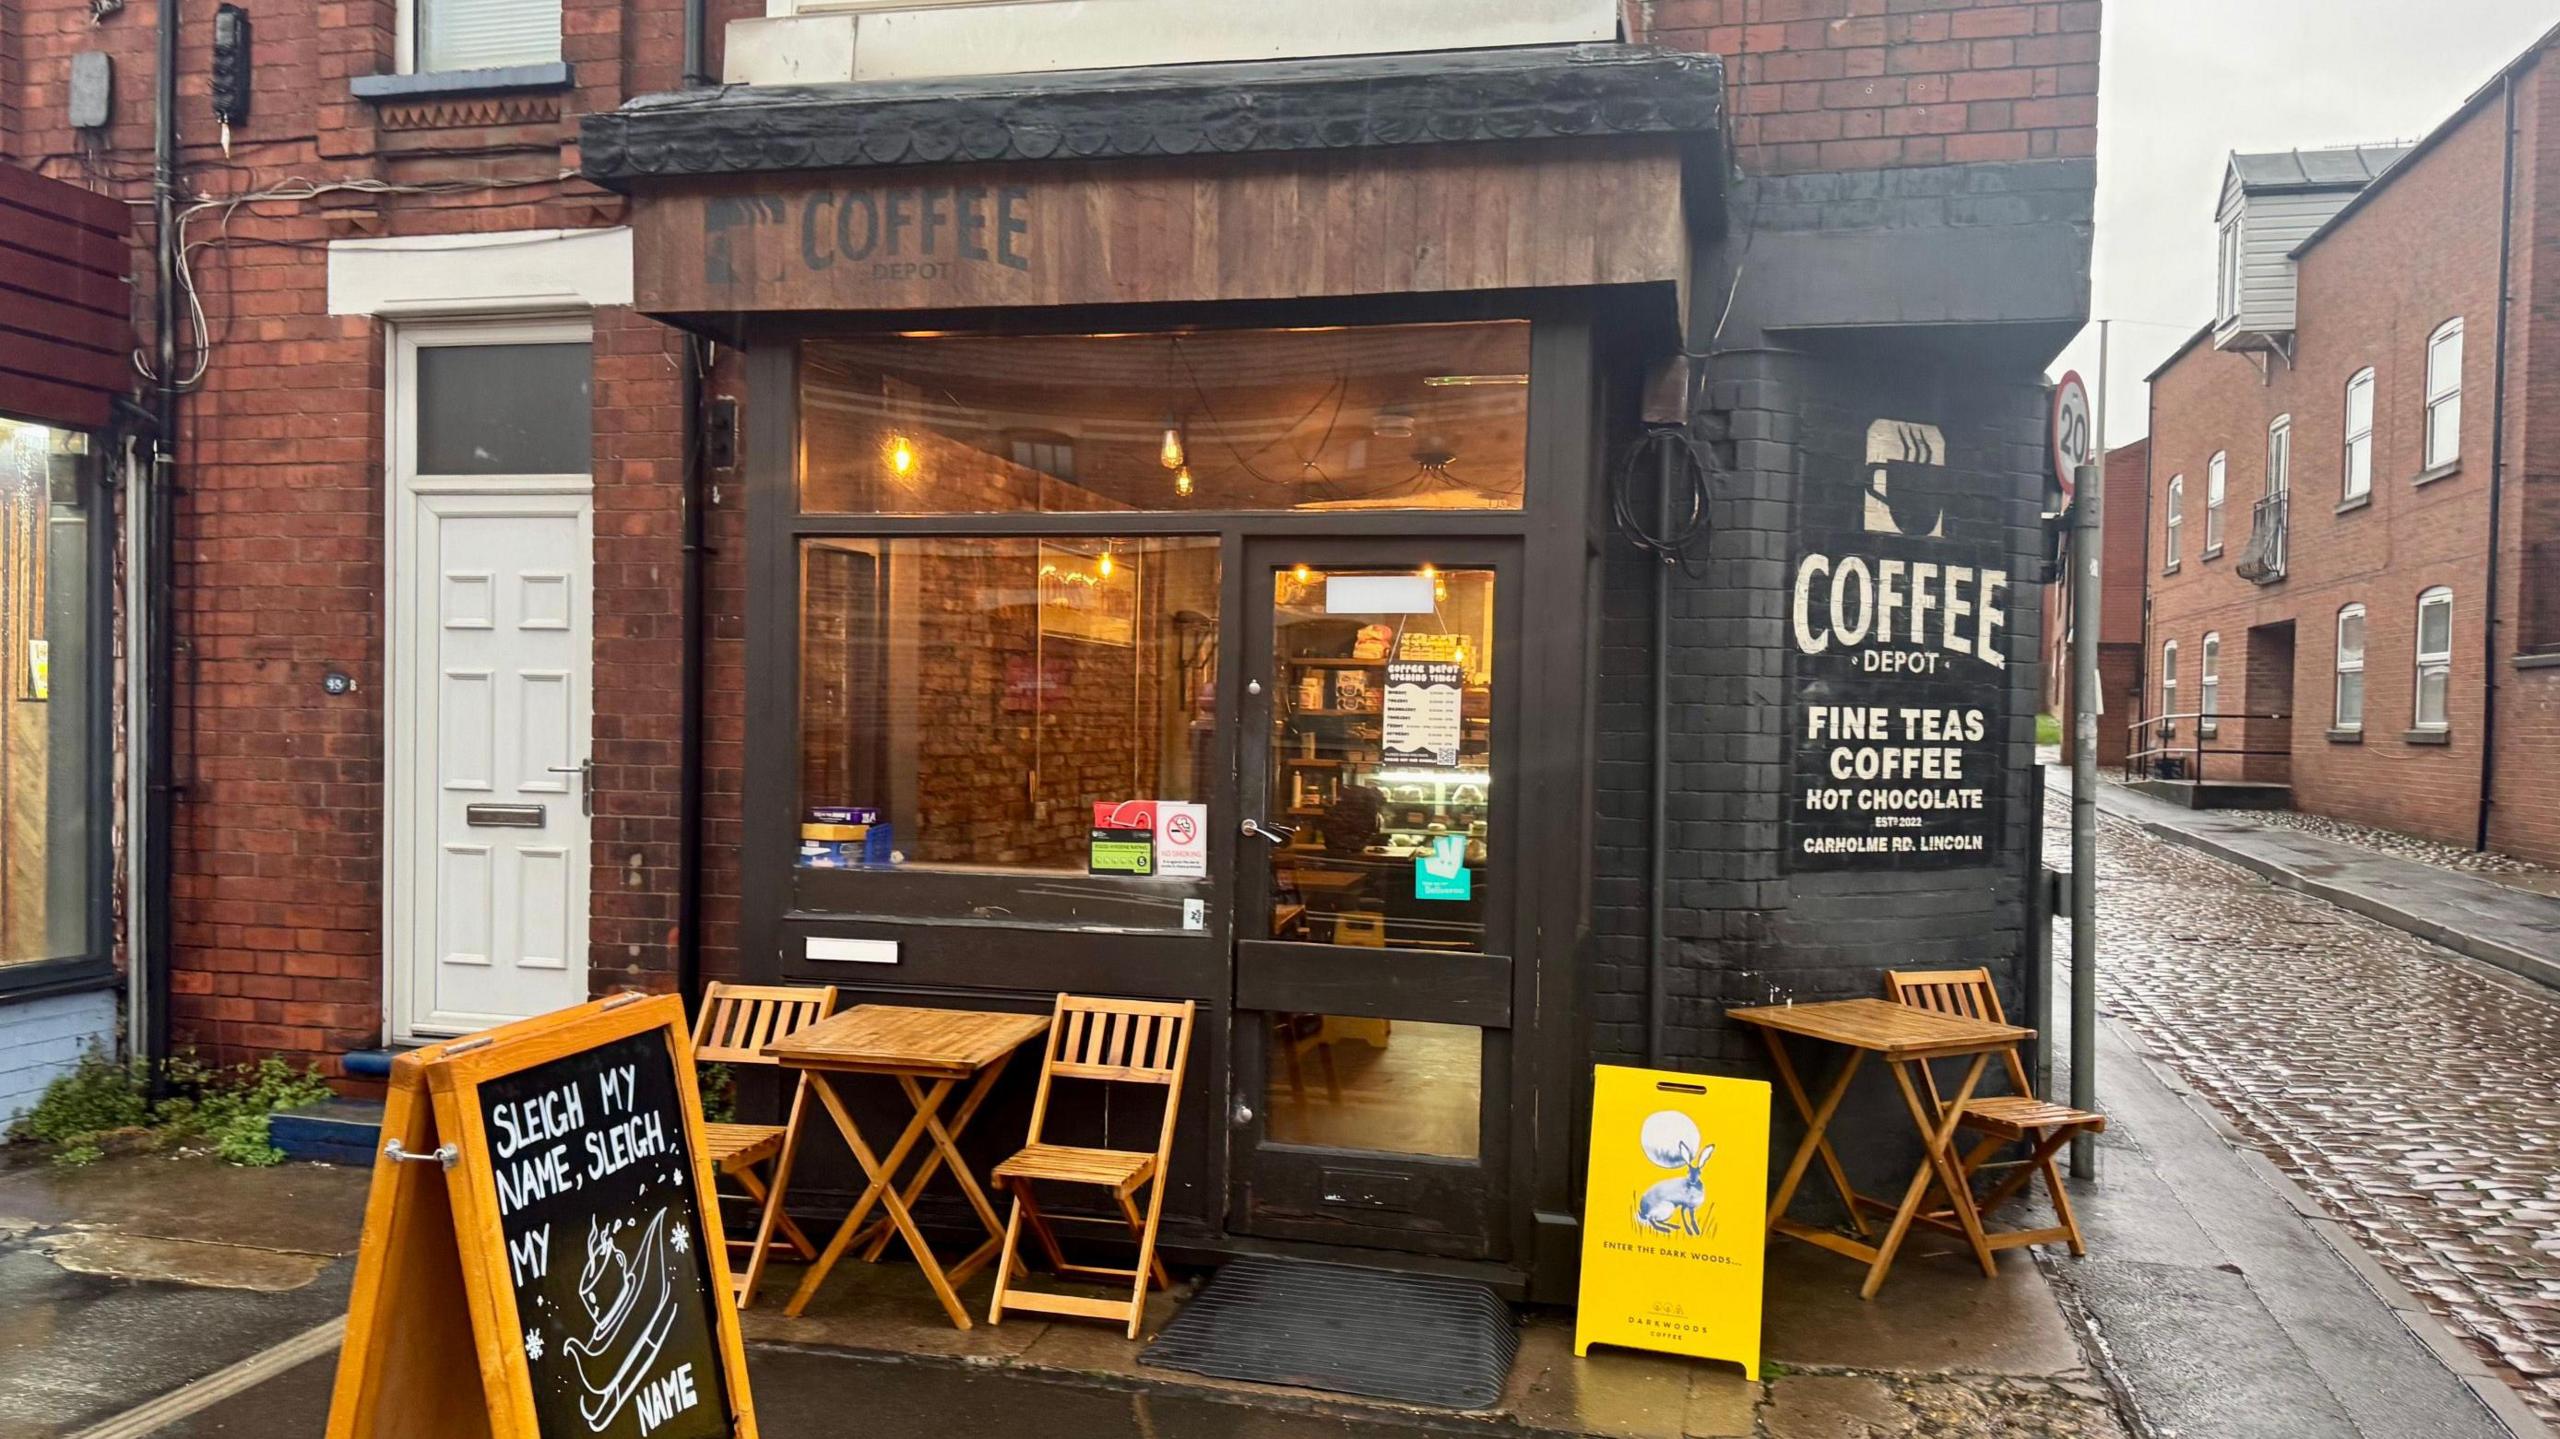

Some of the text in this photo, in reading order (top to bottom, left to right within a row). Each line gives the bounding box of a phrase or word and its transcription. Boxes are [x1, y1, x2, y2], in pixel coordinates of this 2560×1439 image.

[803, 184, 1028, 271] COFFEE
[872, 261, 950, 279] DEPOT
[2061, 403, 2086, 463] 20
[1793, 553, 2008, 670] COFFEE
[1388, 664, 1459, 674] COFFEE DEPOT
[1864, 650, 1940, 674] DEPOT
[1808, 706, 1985, 741] FINE TEAS
[1830, 746, 1963, 780] COFFEE
[1806, 788, 1984, 810] HOT CHOCOLATE
[1899, 816, 1922, 827] 2022
[1804, 835, 1983, 853] CARHOLME RD. LINCOLN
[493, 1063, 636, 1159] SLEIGH MY
[584, 1110, 665, 1182] SLEIGH
[509, 1222, 550, 1288] MY
[1603, 1241, 1743, 1267] ENTER THE DARK WOODS...
[1628, 1316, 1708, 1333] DARKWOODS
[1650, 1331, 1683, 1341] COFFEE
[635, 1361, 698, 1438] NAME
